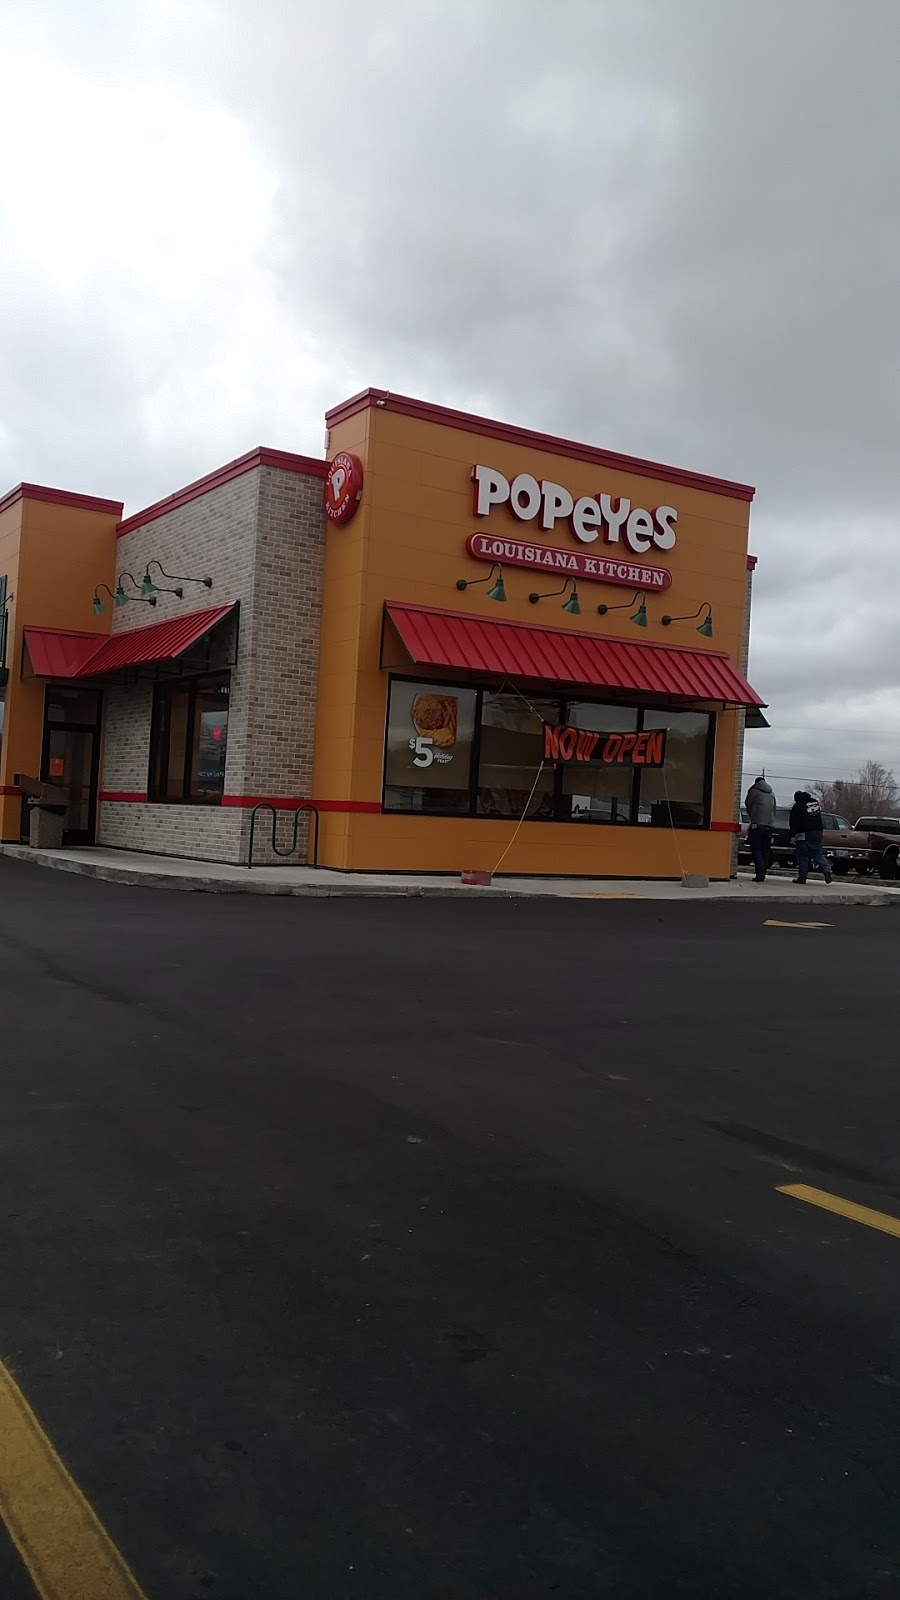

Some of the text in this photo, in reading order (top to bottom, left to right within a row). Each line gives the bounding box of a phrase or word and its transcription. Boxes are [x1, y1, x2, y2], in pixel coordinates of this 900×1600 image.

[480, 538, 665, 586] LOUISIANA KITCHEN
[544, 724, 664, 764] NOW OPEN
